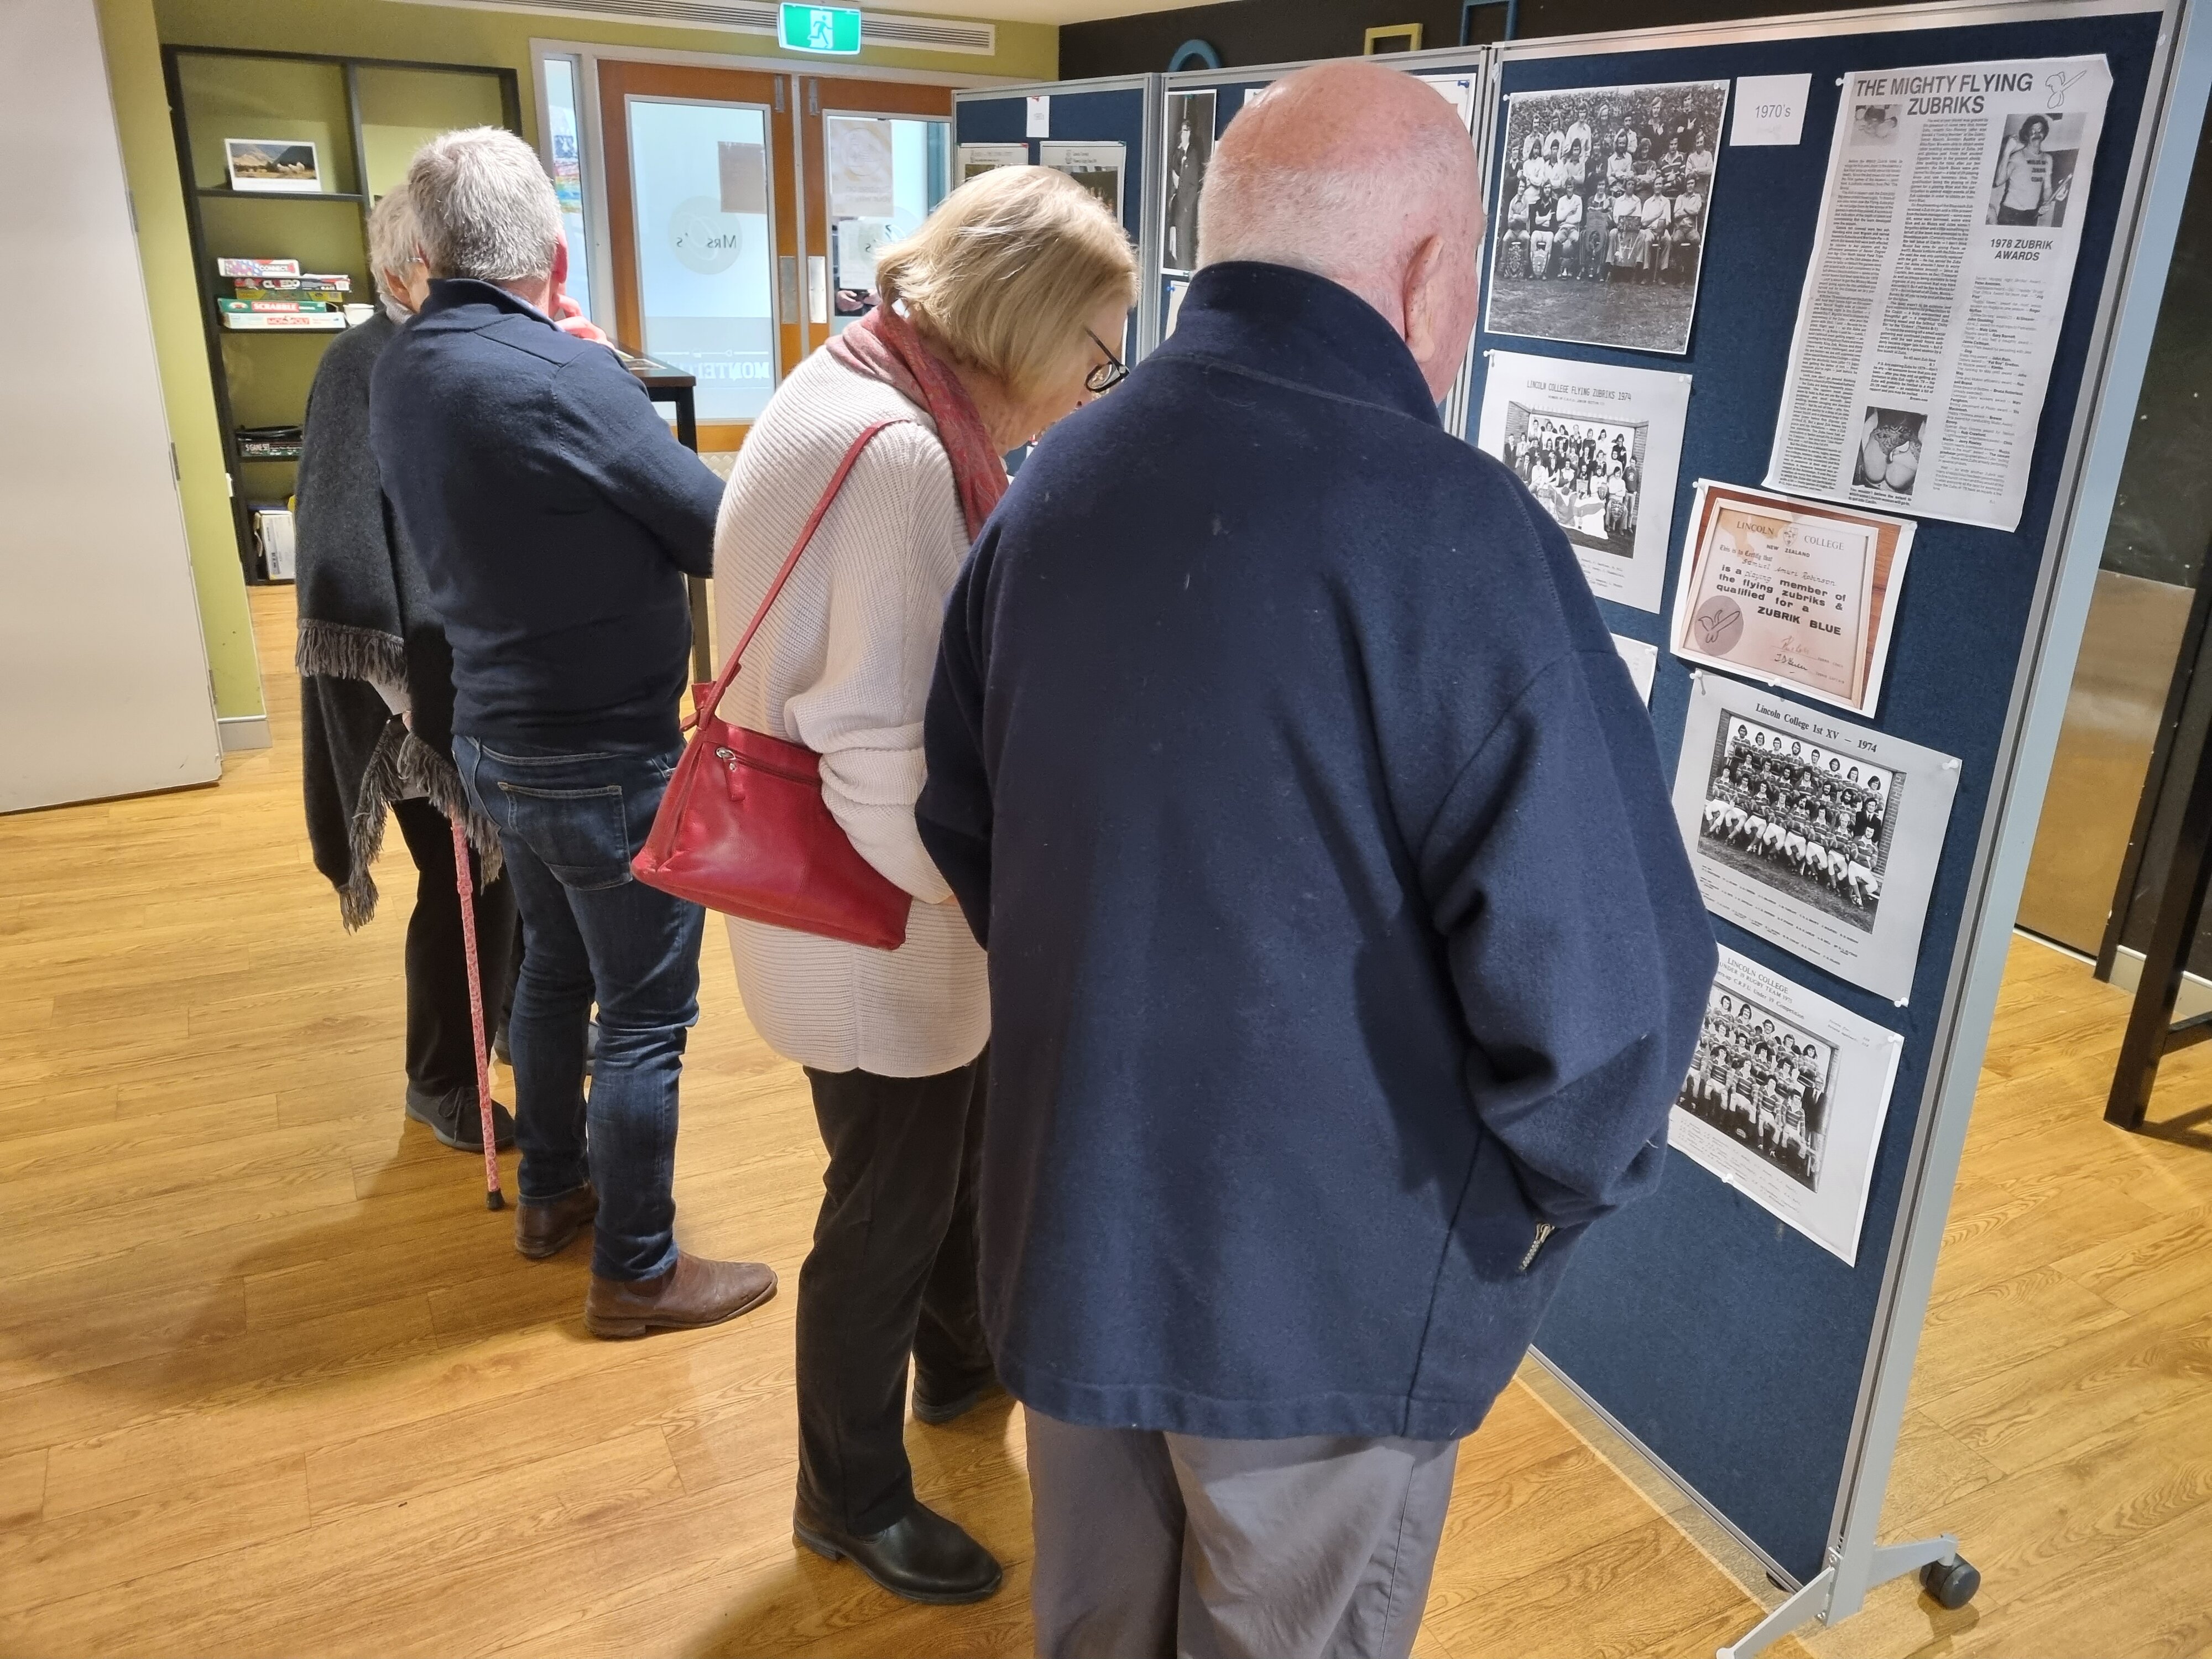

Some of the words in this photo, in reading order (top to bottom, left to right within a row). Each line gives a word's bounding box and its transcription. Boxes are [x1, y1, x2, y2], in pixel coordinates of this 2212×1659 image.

[1857, 79, 1887, 97] THE
[1890, 75, 1957, 95] MIGHTY
[1959, 73, 2033, 93] FLYING
[1756, 104, 1791, 118] 1970's
[1907, 95, 1985, 115] ZUBRIKS
[1991, 239, 2013, 248] 1978
[2014, 239, 2053, 249] ZUBRIK
[1995, 251, 2040, 261] AWARDS
[1527, 380, 1546, 390] LINCOLN
[1548, 383, 1569, 393] COLLEGE
[1572, 386, 1590, 396] FLYING
[1593, 388, 1616, 399] ZUBRIKS
[1618, 392, 1631, 400] 1974
[1736, 521, 1774, 535] LINCOLN
[1804, 535, 1844, 550] COLLEGE
[1719, 544, 1730, 552] This
[1785, 548, 1810, 558] ZEALAND
[1802, 571, 1837, 587] Robinson
[1717, 583, 1765, 601] qualified
[1776, 597, 1793, 608] for
[1719, 573, 1736, 583] the
[1743, 579, 1773, 593] flying
[1782, 590, 1825, 606] zubriks
[1835, 602, 1843, 611] &
[1780, 580, 1828, 596] member
[1835, 593, 1846, 602] of
[1757, 606, 1801, 624] ZUBRIK
[1809, 620, 1841, 635] BLUE
[1755, 703, 1781, 719] Lincoln
[1784, 713, 1809, 730] College
[1813, 724, 1823, 735] 1st
[1825, 729, 1839, 740] XV
[1857, 739, 1877, 753] 1974
[1719, 962, 1738, 974] UNDER
[1746, 976, 1764, 988] RUGBY
[1766, 985, 1781, 998] TEAM
[1728, 958, 1756, 977] LINCOLN
[1758, 974, 1788, 994] COLLEGE
[1754, 989, 1766, 999] Under
[1776, 1001, 1804, 1019] Competition
